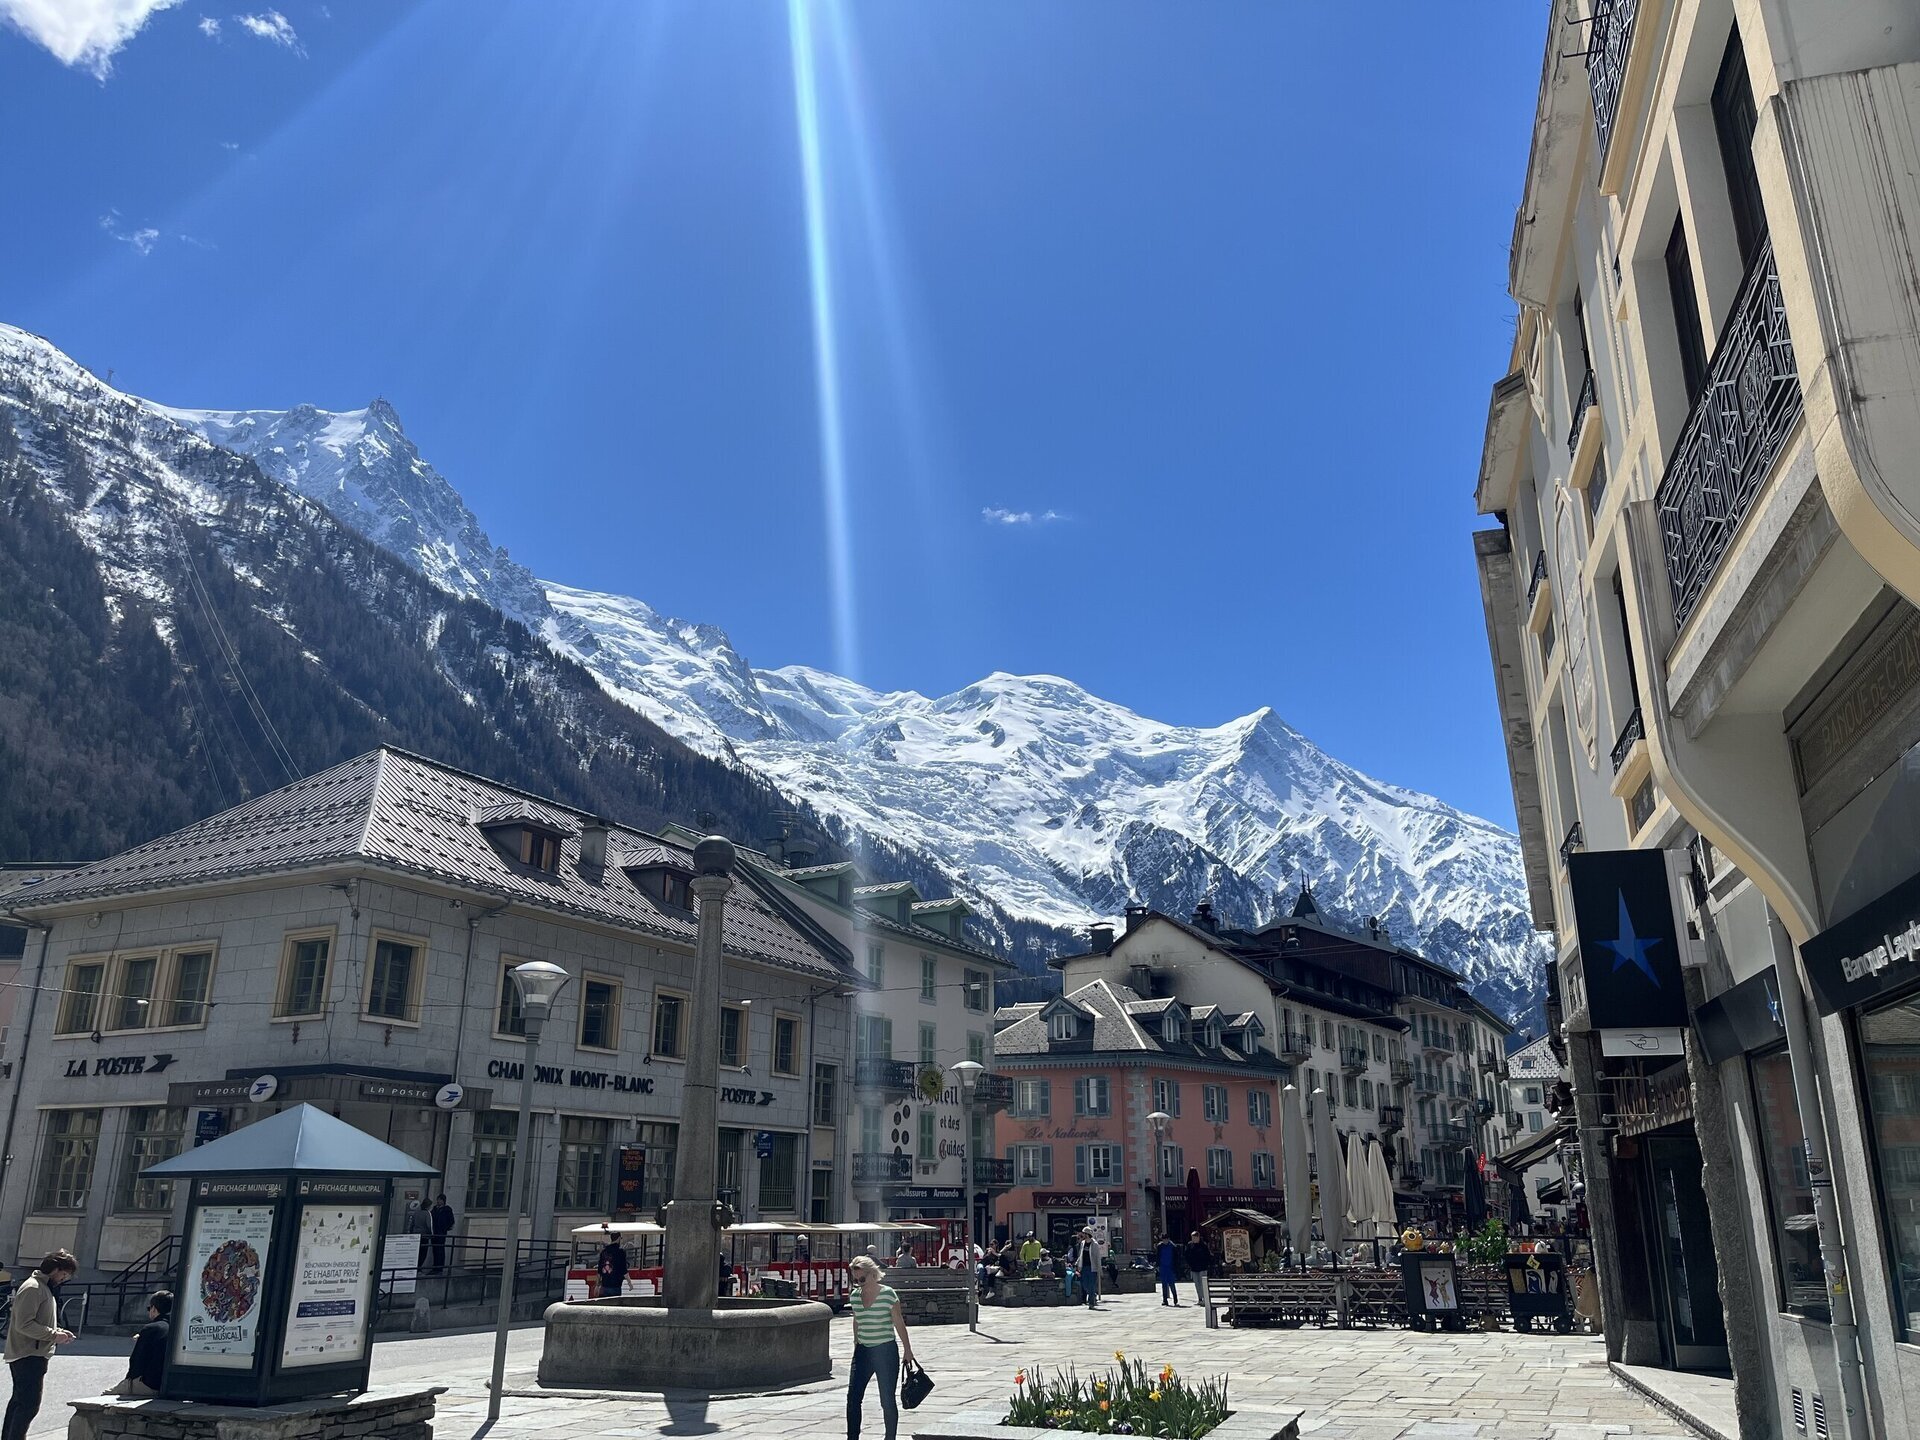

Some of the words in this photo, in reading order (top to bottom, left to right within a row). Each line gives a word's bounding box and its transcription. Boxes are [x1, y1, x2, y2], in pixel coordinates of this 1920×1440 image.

[1822, 684, 1871, 757] BANQUE
[1871, 675, 1888, 708] DE
[1841, 945, 1889, 982] Banque
[63, 1060, 87, 1077] LA
[92, 1056, 146, 1076] POSTE
[488, 1060, 564, 1085] CHANIX
[570, 1070, 653, 1094] MONT-BLANC
[197, 1088, 210, 1096] LA
[216, 1087, 249, 1095] POSTE
[370, 1086, 384, 1094] LA
[392, 1088, 429, 1097] POSTE
[720, 1087, 756, 1105] POSTE
[940, 1115, 947, 1128] et
[948, 1115, 960, 1131] des
[939, 1139, 966, 1159] Guides
[212, 1184, 247, 1192] AFFICHAGE
[247, 1184, 282, 1192] MUNICIPAL
[313, 1184, 347, 1192] AFFICHAGE
[349, 1185, 381, 1193] MUNICIPAL
[933, 1188, 959, 1198] Armando
[304, 1271, 312, 1279] DE
[313, 1269, 342, 1279] L'HABITAT
[343, 1268, 359, 1278] PRIVÉ
[191, 1325, 226, 1335] PRINTEMPS
[212, 1331, 239, 1341] MUSICAL
